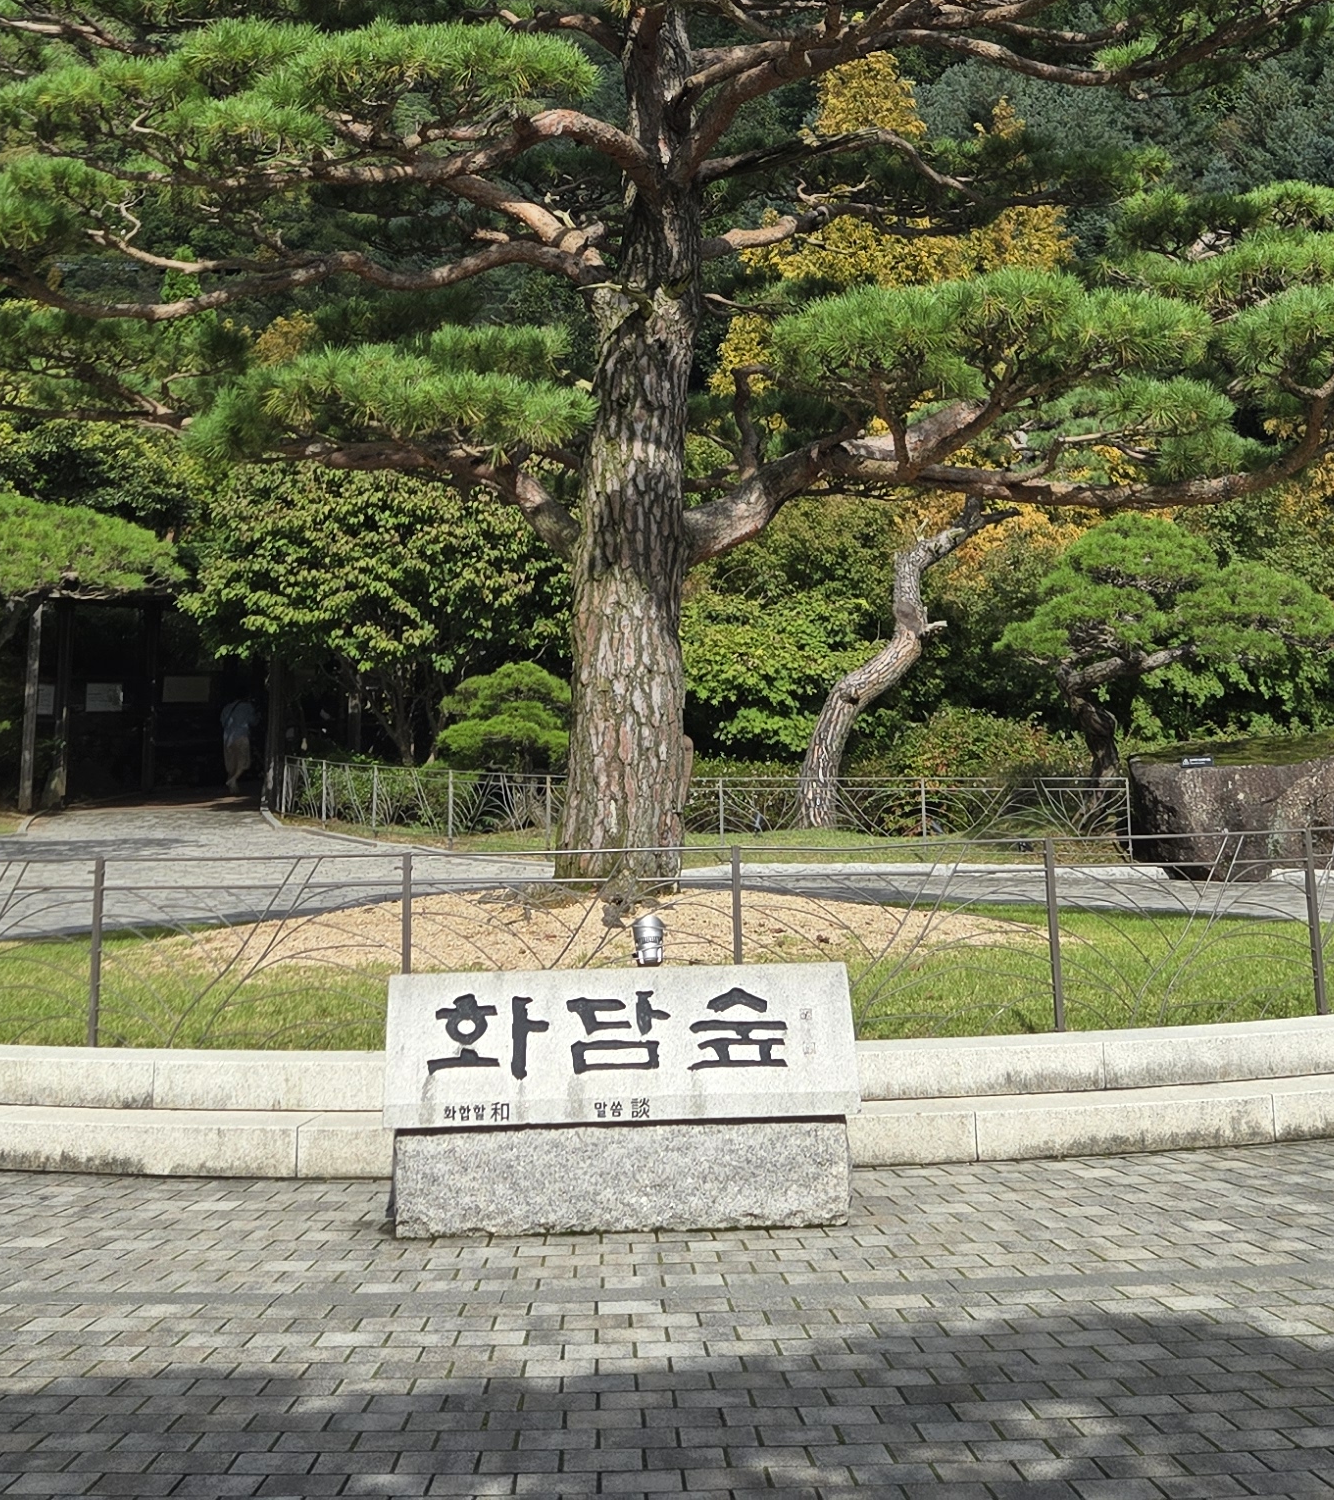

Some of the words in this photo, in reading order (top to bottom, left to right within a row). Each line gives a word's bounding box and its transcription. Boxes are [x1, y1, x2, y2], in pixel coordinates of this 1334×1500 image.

[426, 987, 789, 1081] 화담숲
[443, 1103, 486, 1121] 화합할
[490, 1101, 510, 1122] 和
[594, 1100, 623, 1118] 말씀
[630, 1097, 650, 1118] 談
